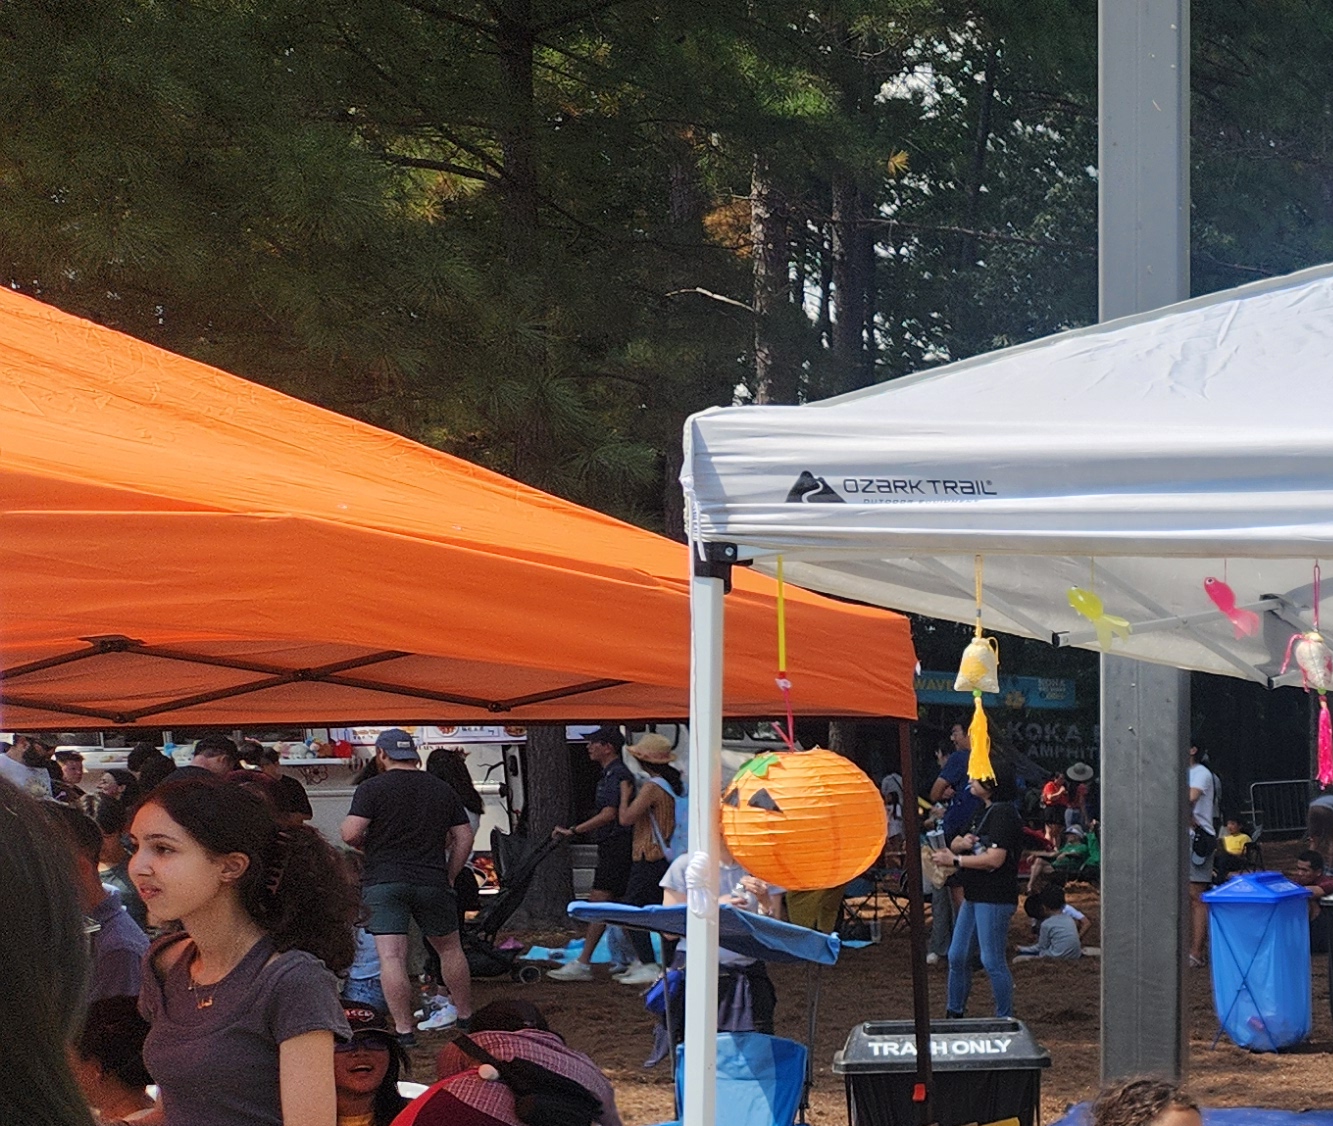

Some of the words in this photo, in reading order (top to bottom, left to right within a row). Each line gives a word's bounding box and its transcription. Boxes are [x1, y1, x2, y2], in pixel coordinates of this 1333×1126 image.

[1007, 721, 1082, 743] KOKA
[1027, 744, 1100, 760] AMPHIT
[868, 1040, 948, 1056] TRAH
[951, 1038, 1012, 1055] ONLY
